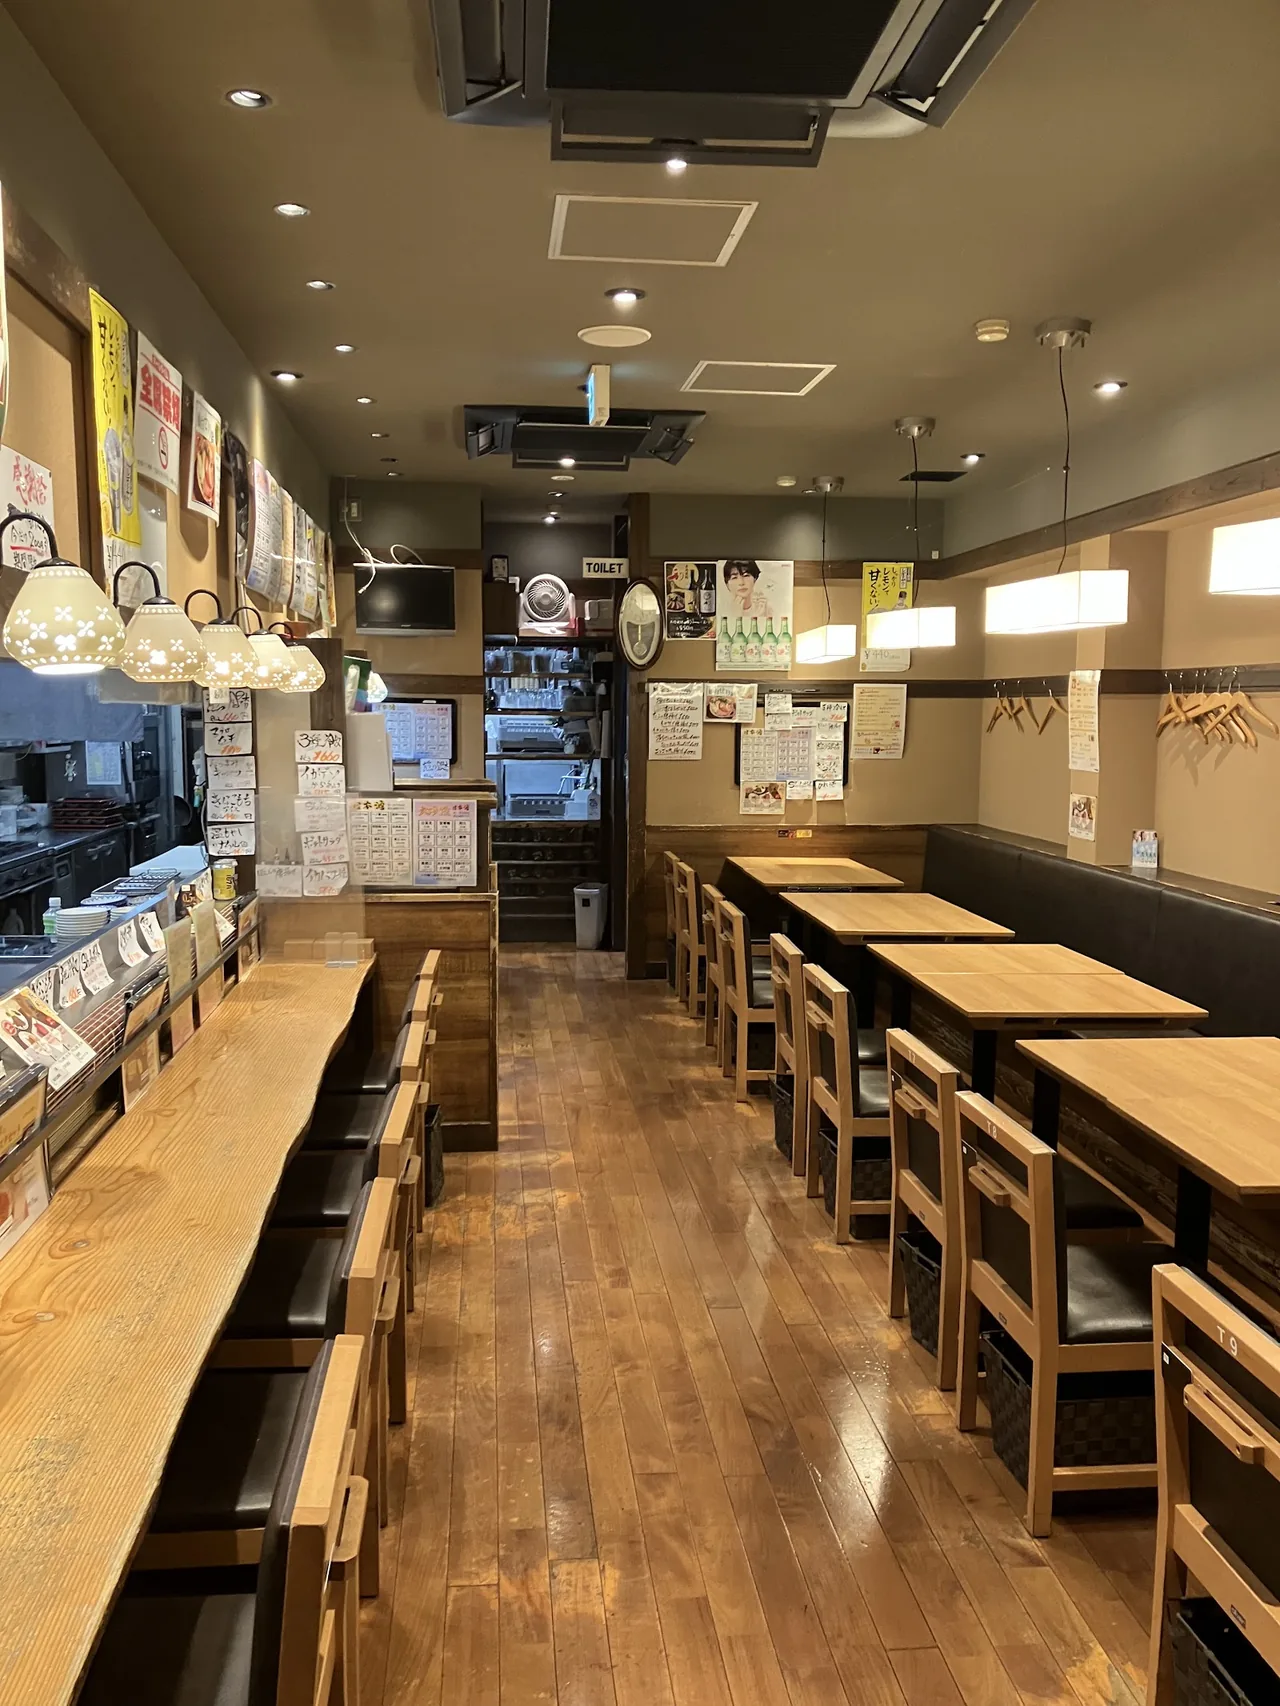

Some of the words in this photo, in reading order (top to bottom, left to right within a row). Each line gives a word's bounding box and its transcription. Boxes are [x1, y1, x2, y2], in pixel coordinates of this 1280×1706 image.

[586, 562, 624, 574] TOILET
[986, 1120, 998, 1139] T8
[1216, 1324, 1238, 1357] T9
